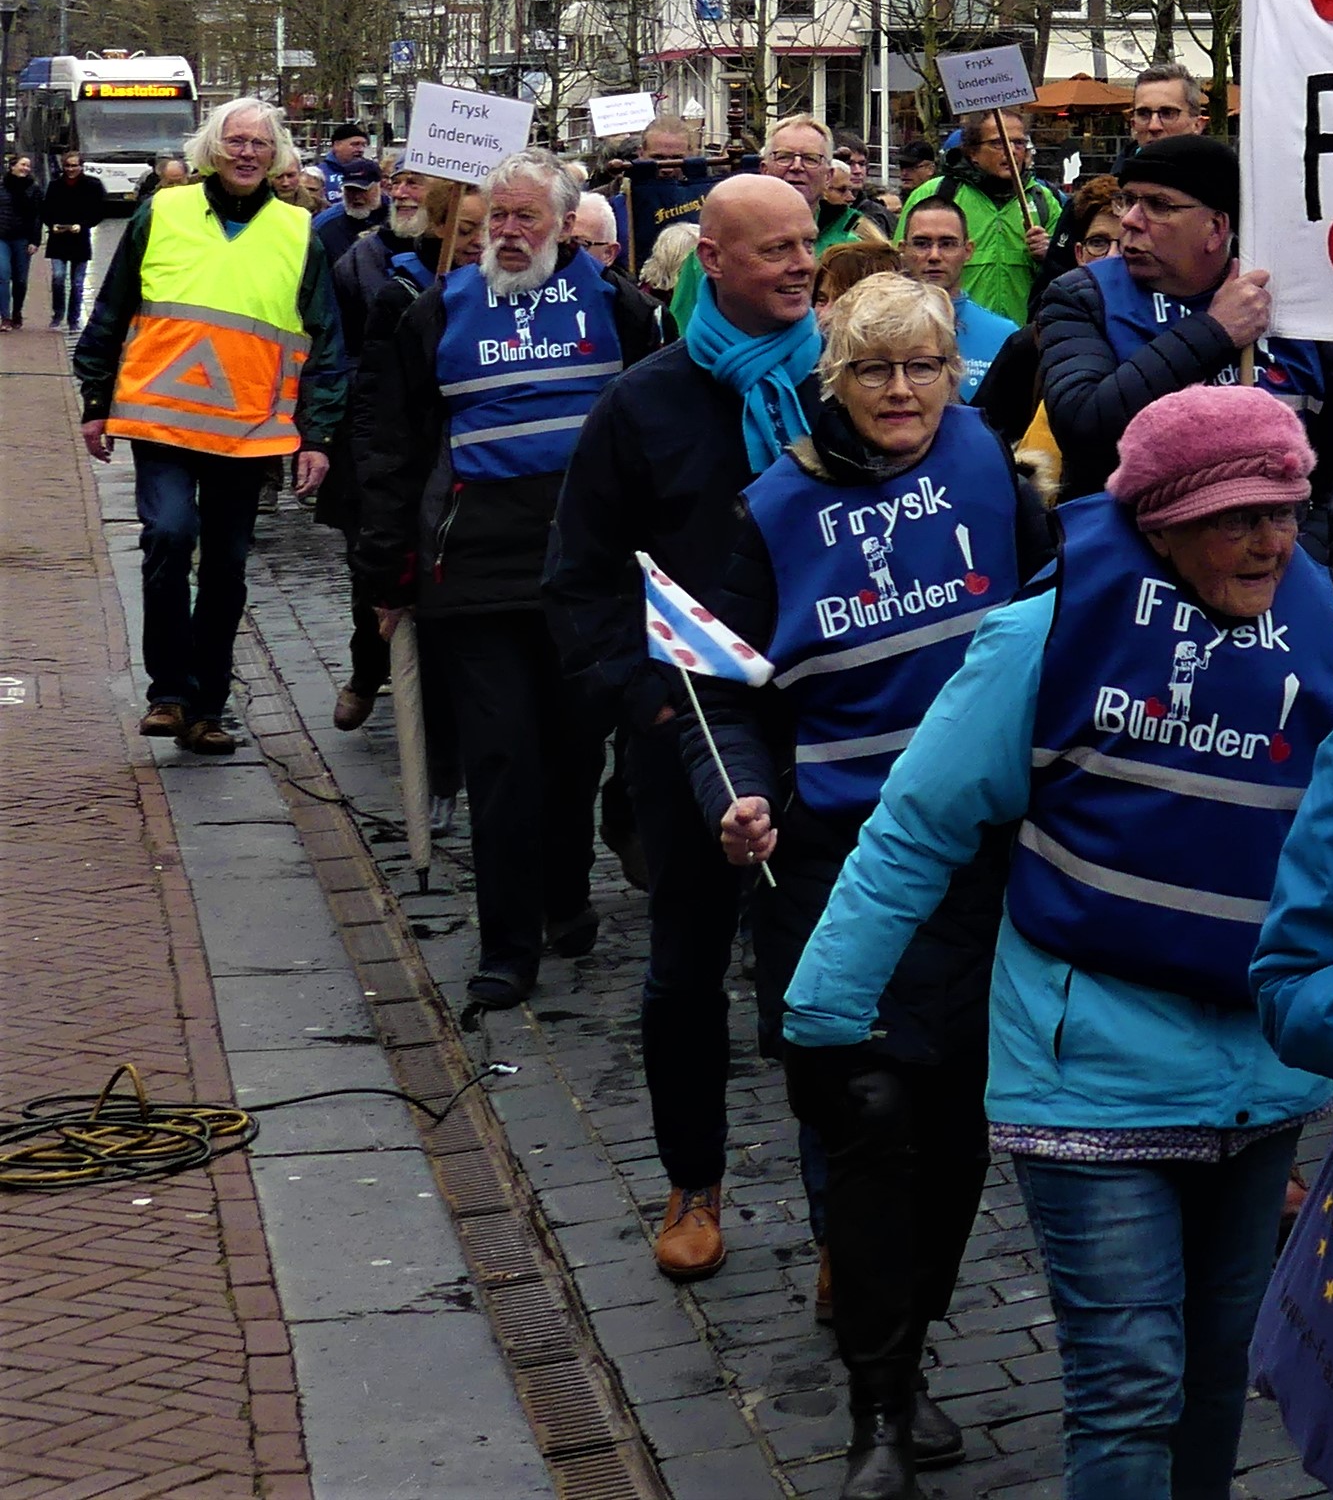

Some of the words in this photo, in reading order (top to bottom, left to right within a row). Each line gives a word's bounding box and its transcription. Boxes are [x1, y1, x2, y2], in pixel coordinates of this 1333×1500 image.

[965, 56, 994, 70] Frysk
[99, 83, 177, 97] Busstation
[966, 87, 1028, 107] bernerjocht
[451, 100, 490, 119] Frysk
[428, 122, 503, 152] ûnderwiis,
[410, 148, 424, 164] in
[427, 151, 493, 178] bernerjo
[818, 476, 953, 547] Frysk
[1135, 577, 1291, 652] Frysk
